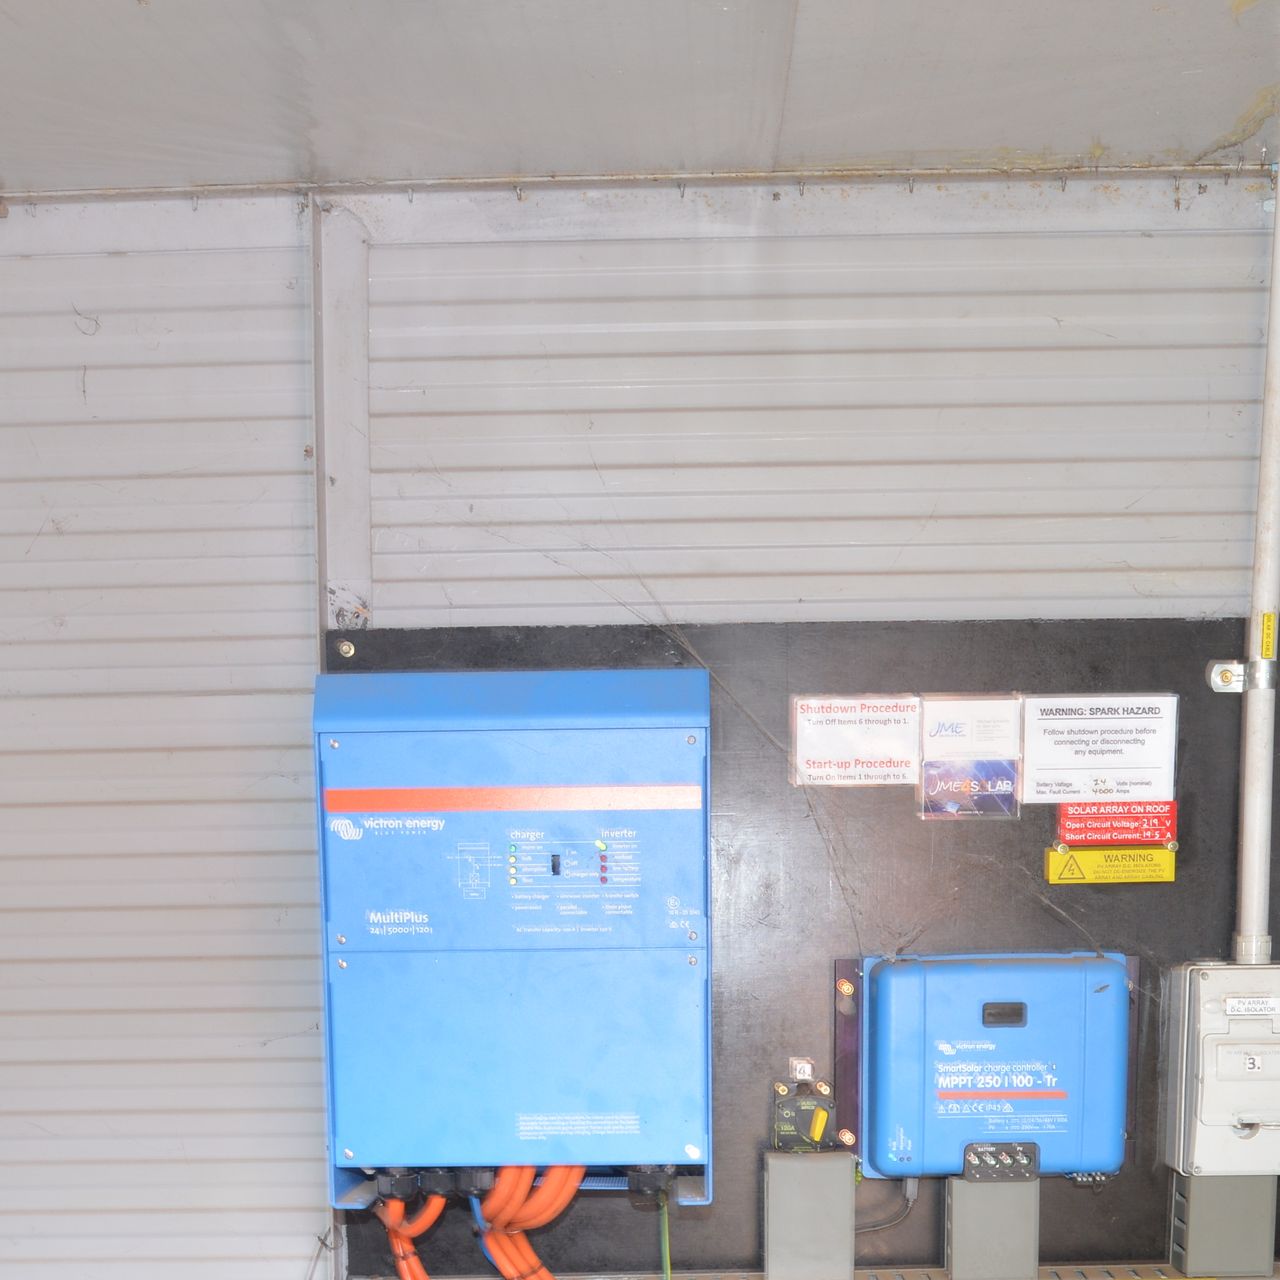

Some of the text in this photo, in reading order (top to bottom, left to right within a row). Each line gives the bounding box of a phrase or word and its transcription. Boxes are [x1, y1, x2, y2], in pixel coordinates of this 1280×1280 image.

[800, 703, 917, 714] Shutdown Procedure
[1040, 707, 1161, 716] WARNING: SPARK HAZARD
[864, 718, 892, 726] through
[929, 721, 966, 738] JME
[1043, 728, 1065, 736] Follow
[1100, 728, 1133, 737] procedure
[1135, 727, 1157, 735] before
[1054, 738, 1090, 747] connecting
[1100, 738, 1146, 746] disconnecting
[805, 758, 911, 771] Start-up Procedure
[863, 773, 892, 781] through
[1067, 805, 1170, 815] SOLAR ARRAY ON ROOF
[364, 817, 445, 831] victron energy
[1065, 821, 1085, 830] Open
[1086, 821, 1111, 829] Circuit
[510, 830, 545, 841] charger
[601, 829, 636, 838] inverter
[1065, 832, 1085, 840] Short
[1086, 832, 1111, 840] Circuit
[1103, 853, 1154, 863] WARNING
[370, 911, 429, 923] MultiPlus
[938, 1062, 1047, 1073] SmartSolar charge controller
[1247, 1057, 1261, 1070] 3.
[938, 1074, 1058, 1089] MPPT 250 100 Tr
